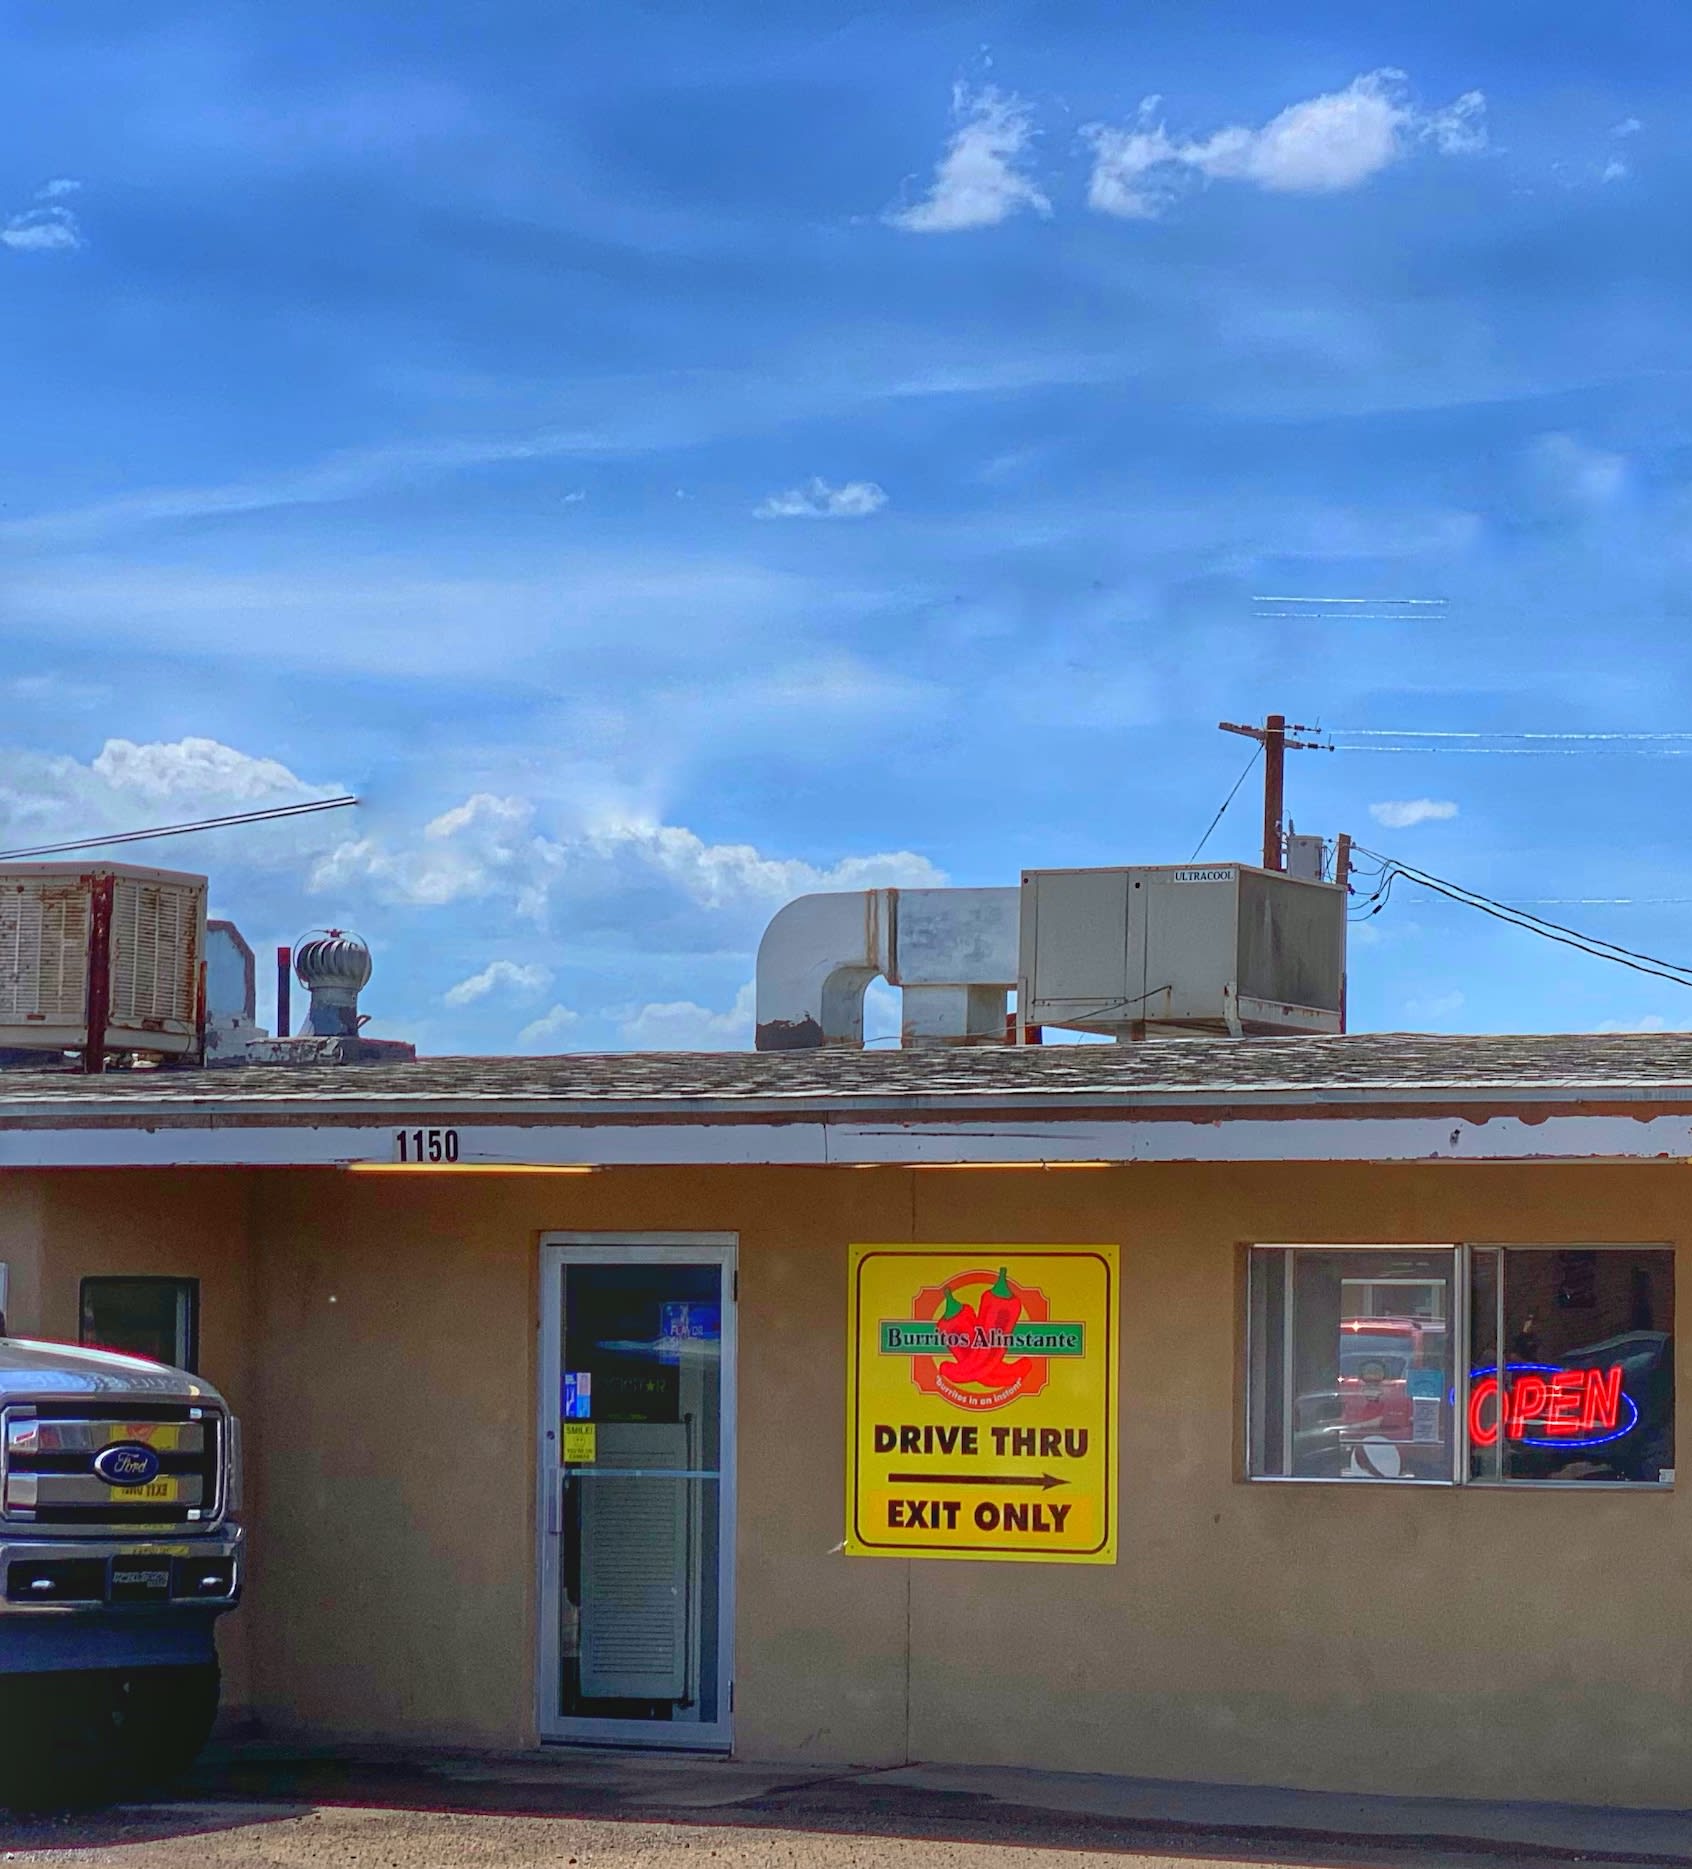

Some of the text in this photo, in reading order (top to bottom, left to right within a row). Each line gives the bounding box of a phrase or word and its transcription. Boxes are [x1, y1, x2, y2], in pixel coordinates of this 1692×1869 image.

[1175, 871, 1233, 881] ULTRACOOL
[396, 1130, 459, 1162] 1150
[887, 1327, 1078, 1348] Burritos Alinstante
[969, 1396, 978, 1405] in
[1470, 1364, 1622, 1446] OPEN
[874, 1424, 1088, 1458] DRIVE THRU
[114, 1452, 148, 1473] Ford
[888, 1499, 1071, 1533] EXIT ONLY
